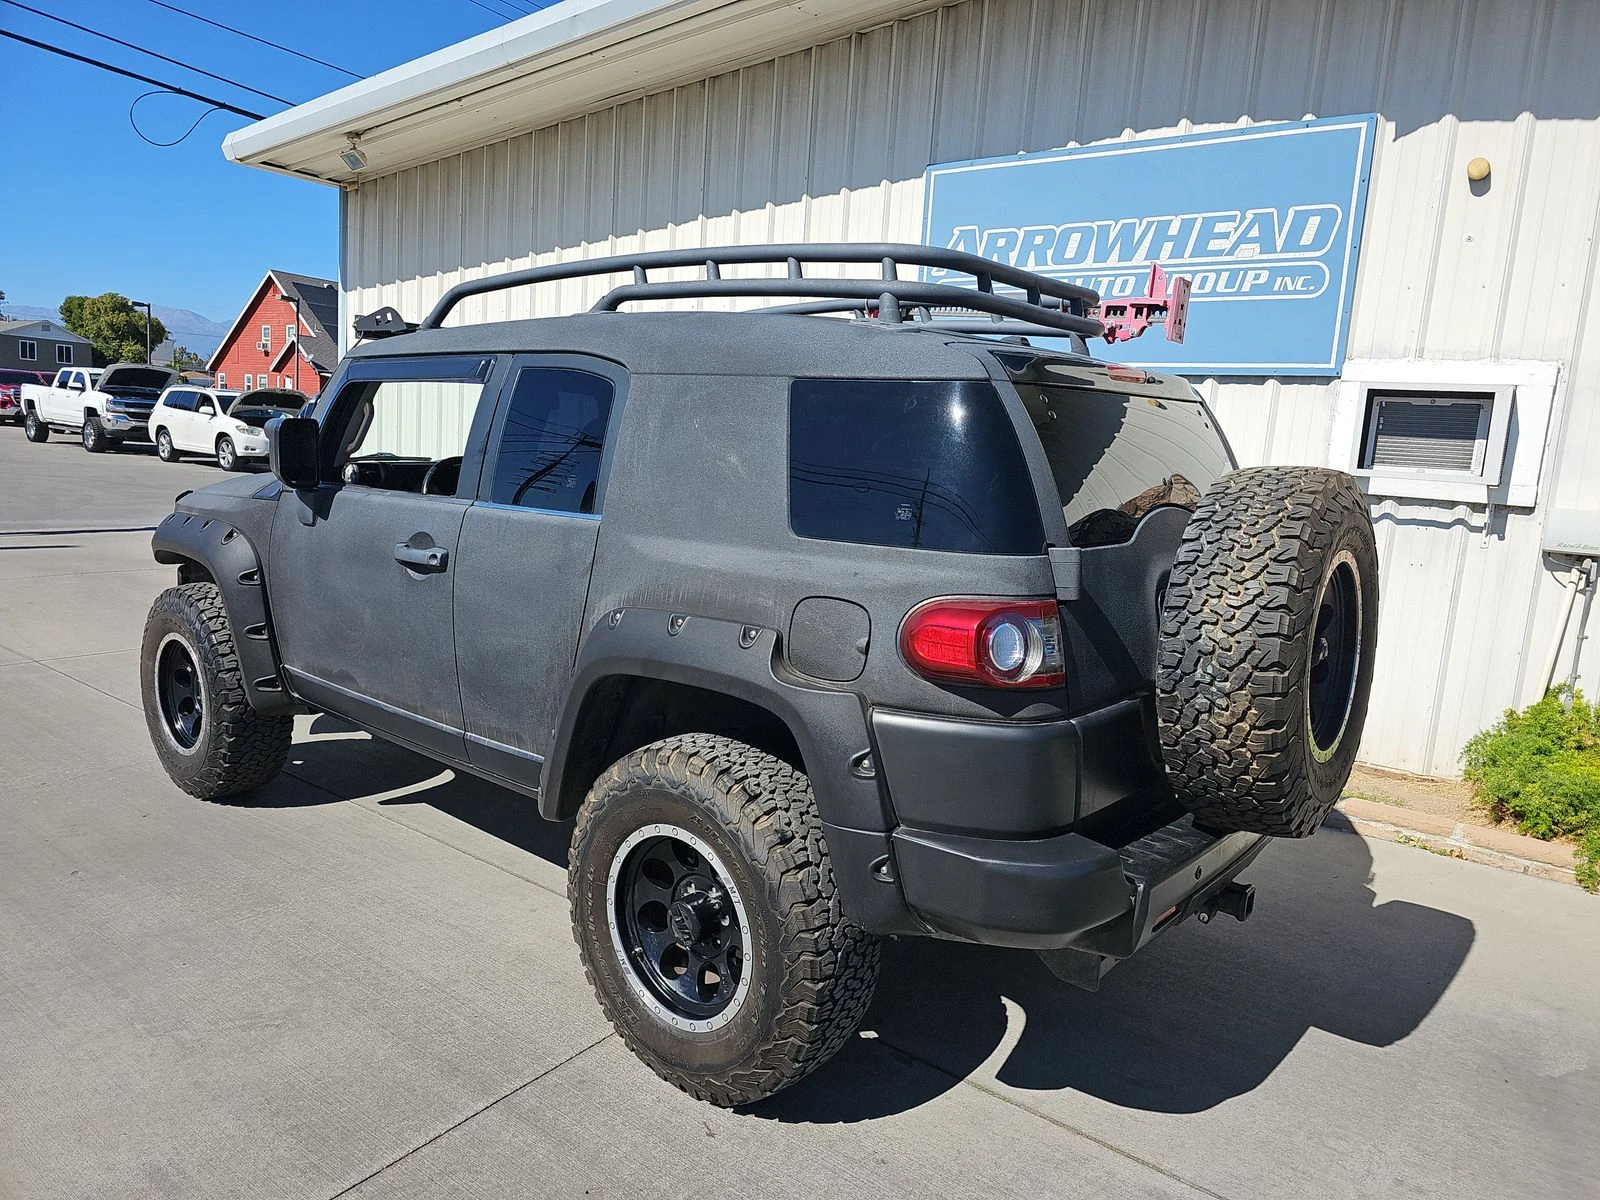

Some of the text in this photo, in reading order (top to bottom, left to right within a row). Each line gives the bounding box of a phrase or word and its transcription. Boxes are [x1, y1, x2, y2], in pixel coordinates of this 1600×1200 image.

[931, 203, 1343, 277] ARROWHEAD
[1143, 269, 1270, 296] ROUP
[1272, 274, 1316, 292] INC.
[728, 886, 741, 906] M/T
